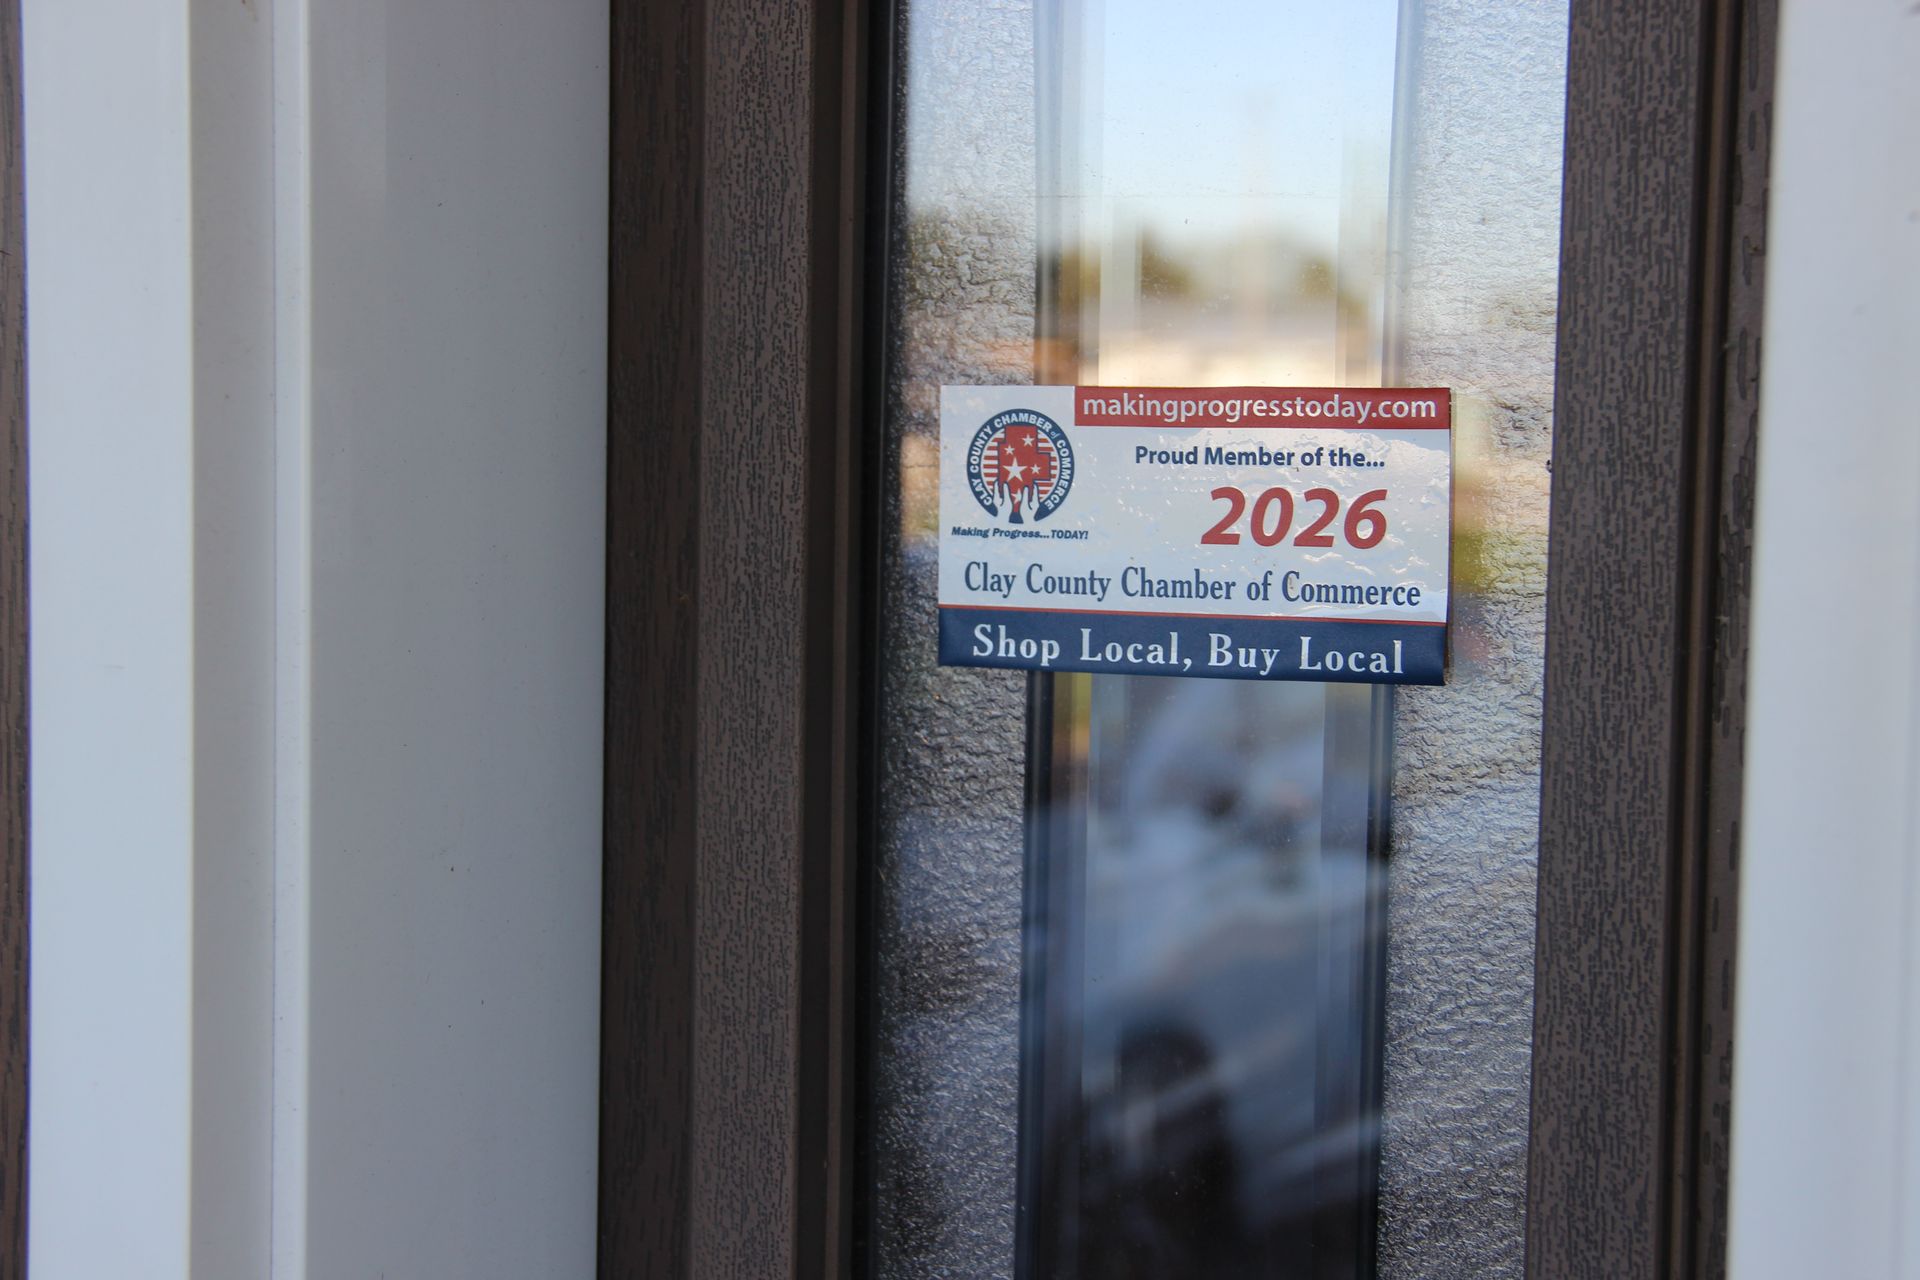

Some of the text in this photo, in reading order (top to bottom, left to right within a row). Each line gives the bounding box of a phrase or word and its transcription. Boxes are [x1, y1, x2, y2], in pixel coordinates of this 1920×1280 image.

[994, 412, 1052, 432] CHAMBER
[1083, 393, 1437, 424] makingprogresstoday.com
[969, 425, 993, 474] COUNTY
[1135, 445, 1385, 467] Proud Member of the...
[971, 478, 993, 506] CLAY
[1044, 439, 1072, 510] COMMERCE
[951, 526, 989, 539] Making
[1200, 486, 1388, 550] 2026
[964, 561, 1421, 606] Clay County Chamber of Commerce
[972, 623, 1404, 676] Shop Local, Buy Local
